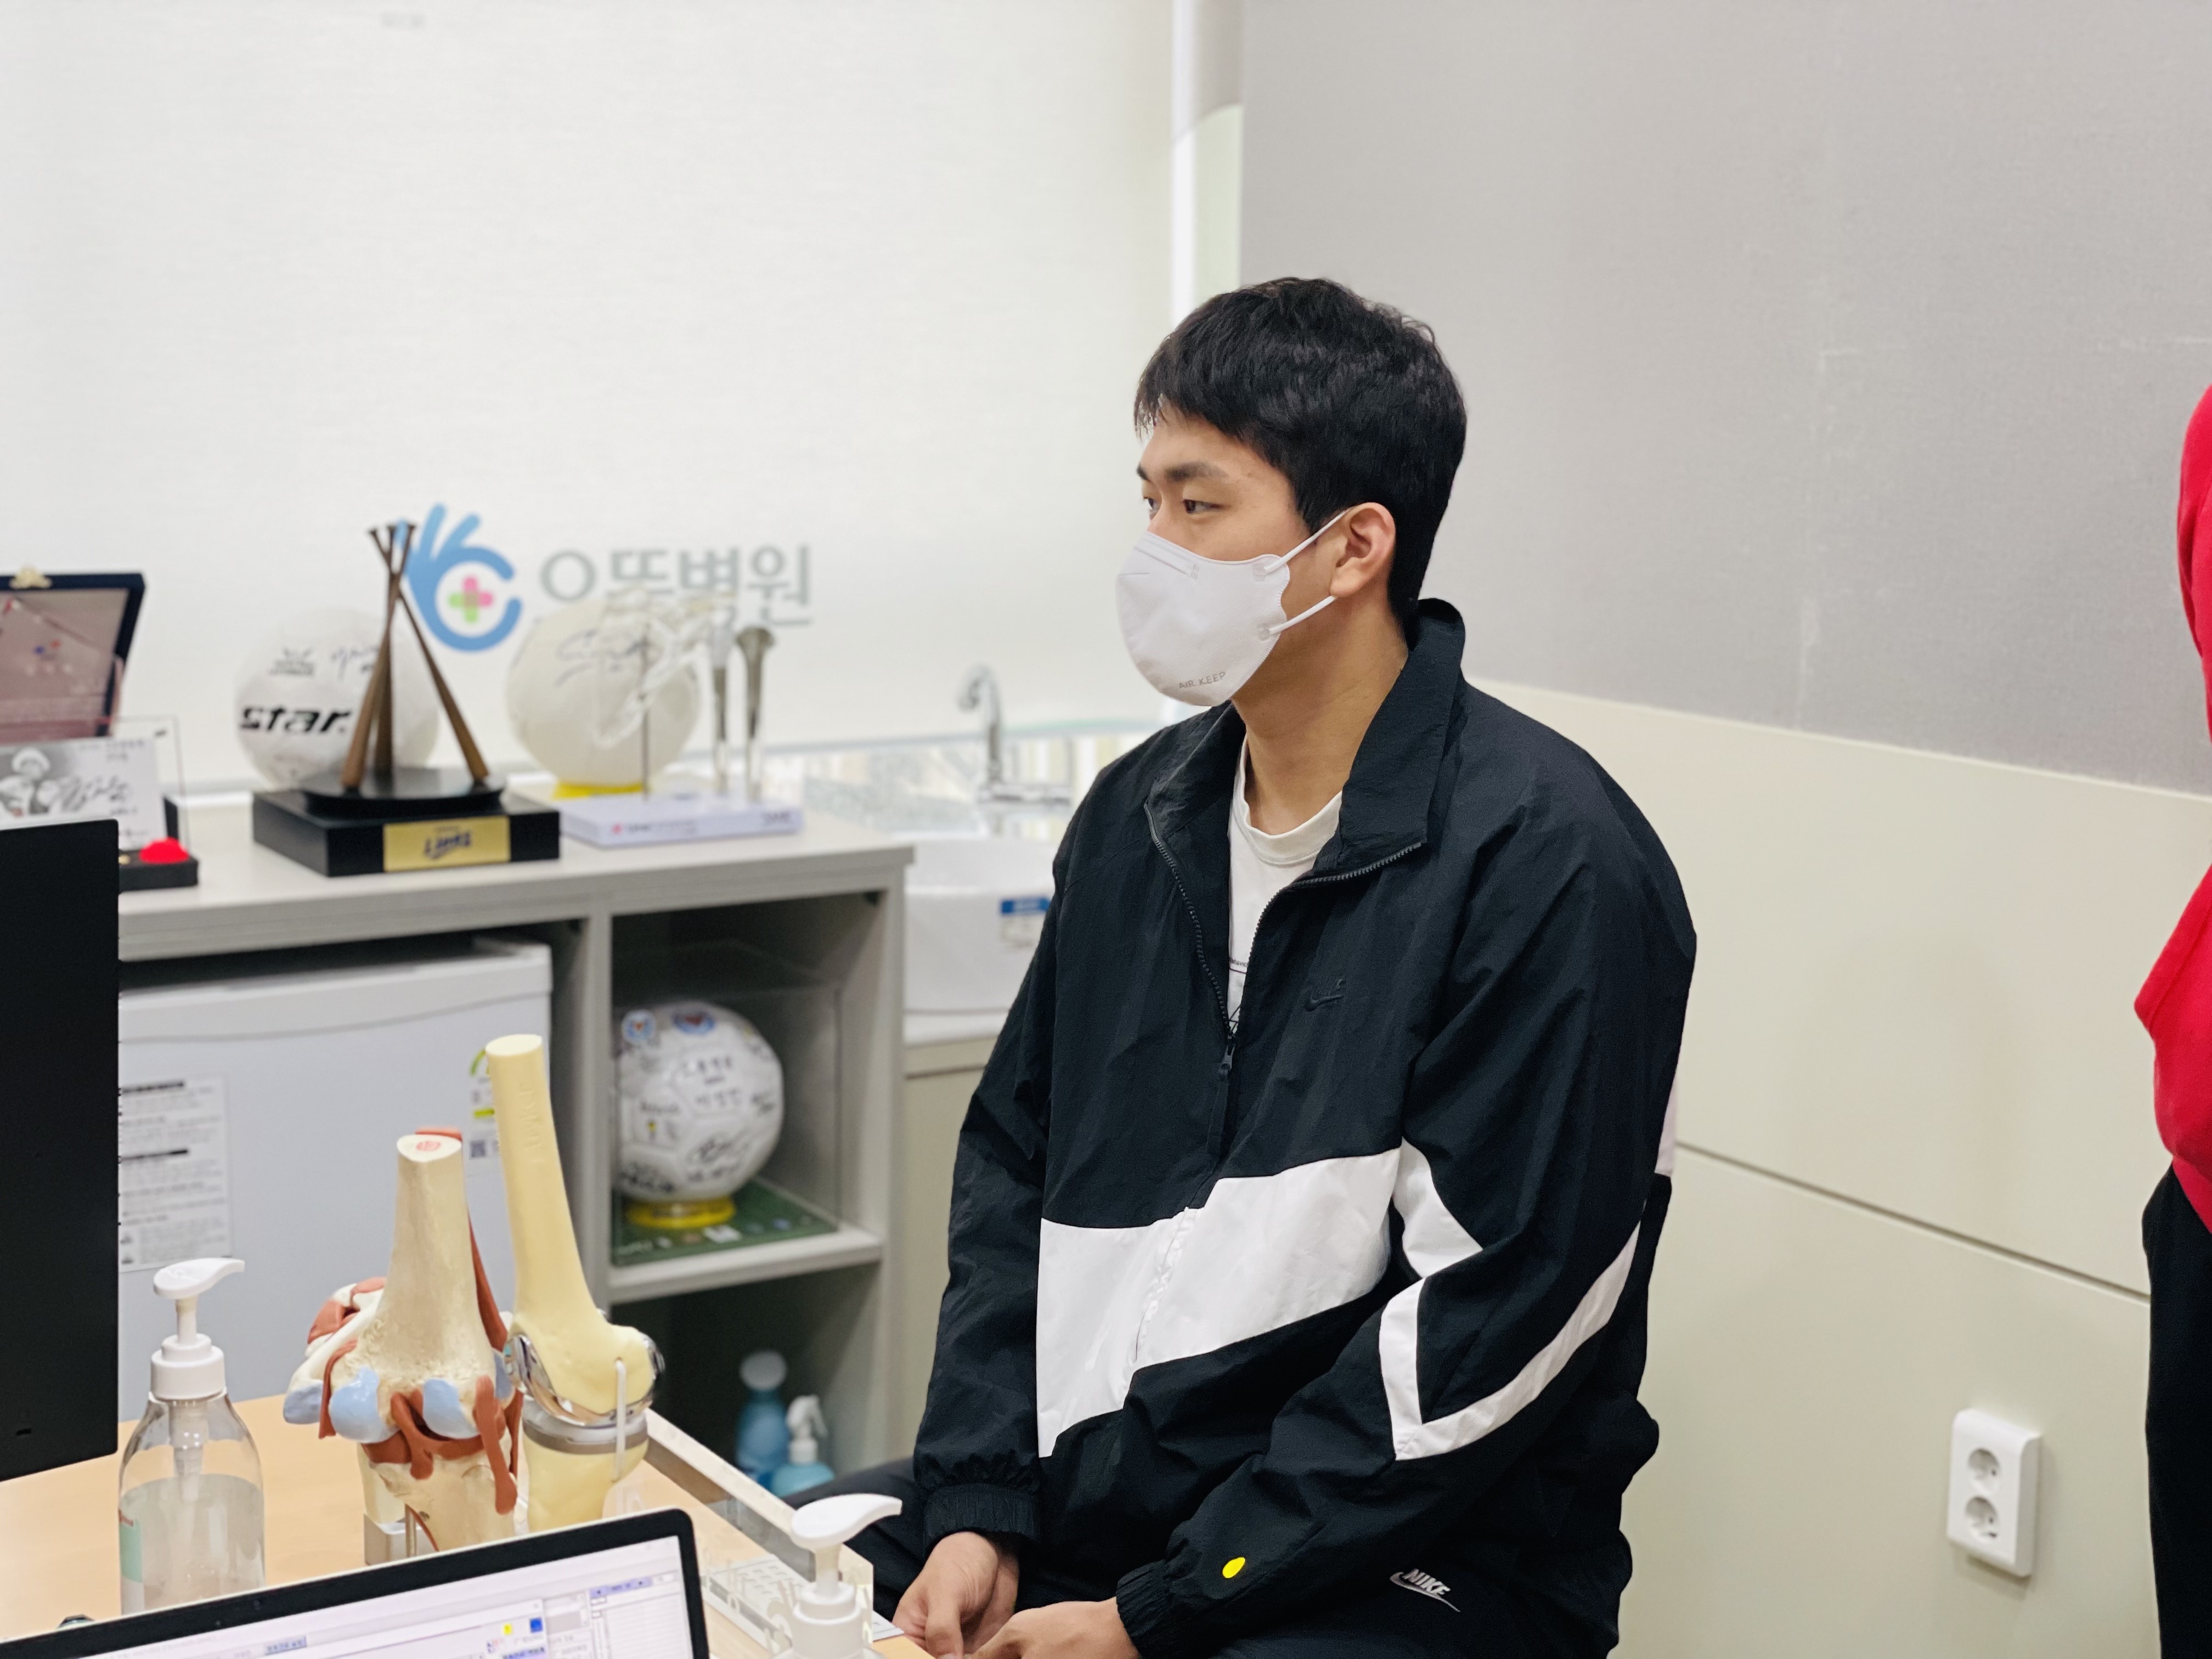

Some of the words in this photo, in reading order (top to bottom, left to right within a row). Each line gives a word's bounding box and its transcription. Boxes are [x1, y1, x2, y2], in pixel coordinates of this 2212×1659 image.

[1179, 680, 1197, 689] AIR
[1198, 671, 1226, 685] KEEP
[240, 705, 352, 733] star
[1401, 1567, 1451, 1595] NIKE
